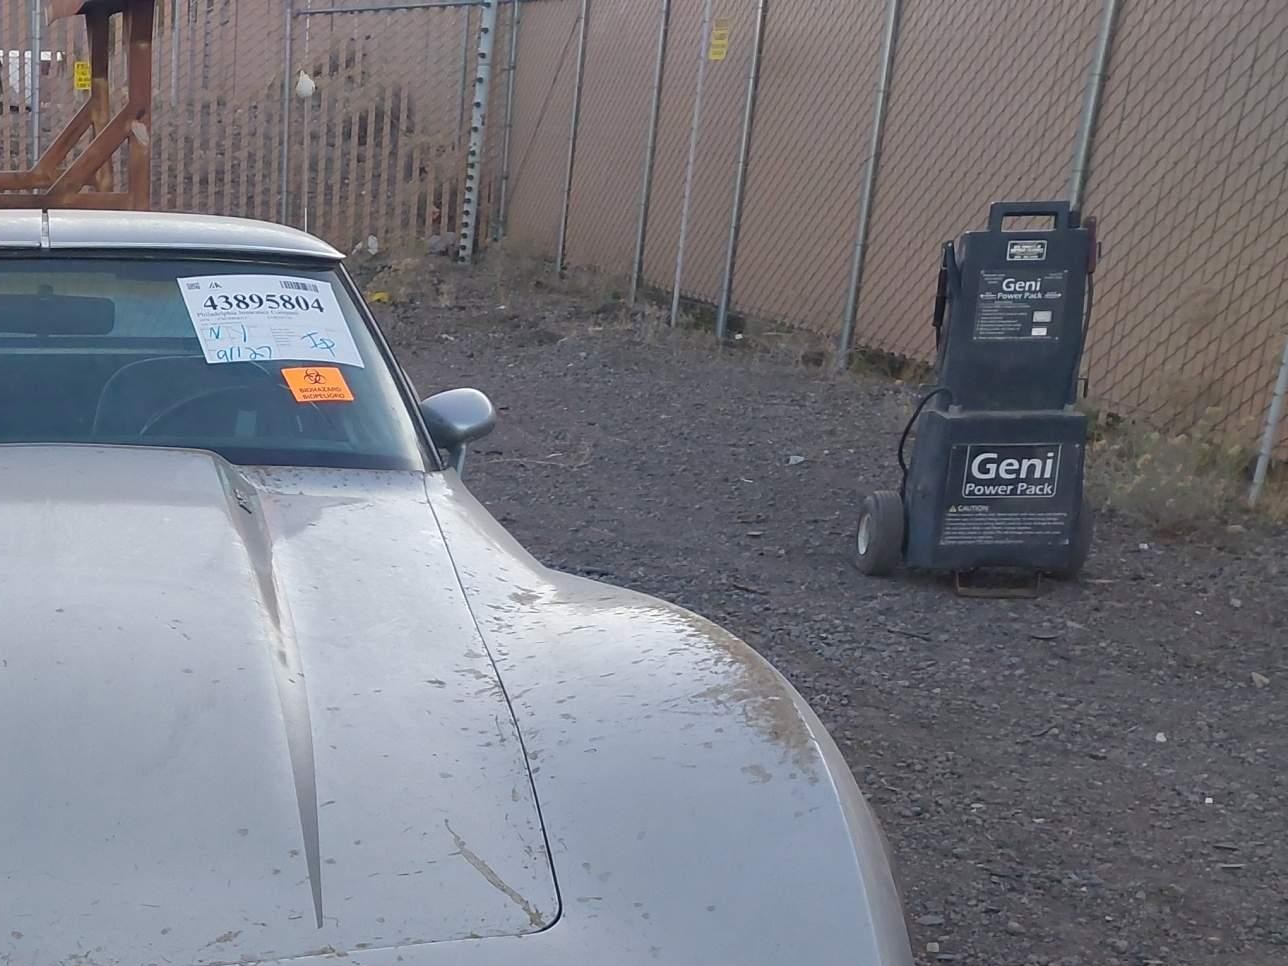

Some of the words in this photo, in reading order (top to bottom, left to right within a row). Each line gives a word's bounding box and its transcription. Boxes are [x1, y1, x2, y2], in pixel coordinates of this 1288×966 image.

[1002, 278, 1042, 291] Geni
[203, 293, 325, 313] 43895804
[971, 452, 1055, 480] Geni
[965, 483, 1015, 495] Power
[1016, 482, 1054, 495] Pack
[958, 505, 989, 513] CAUTION
